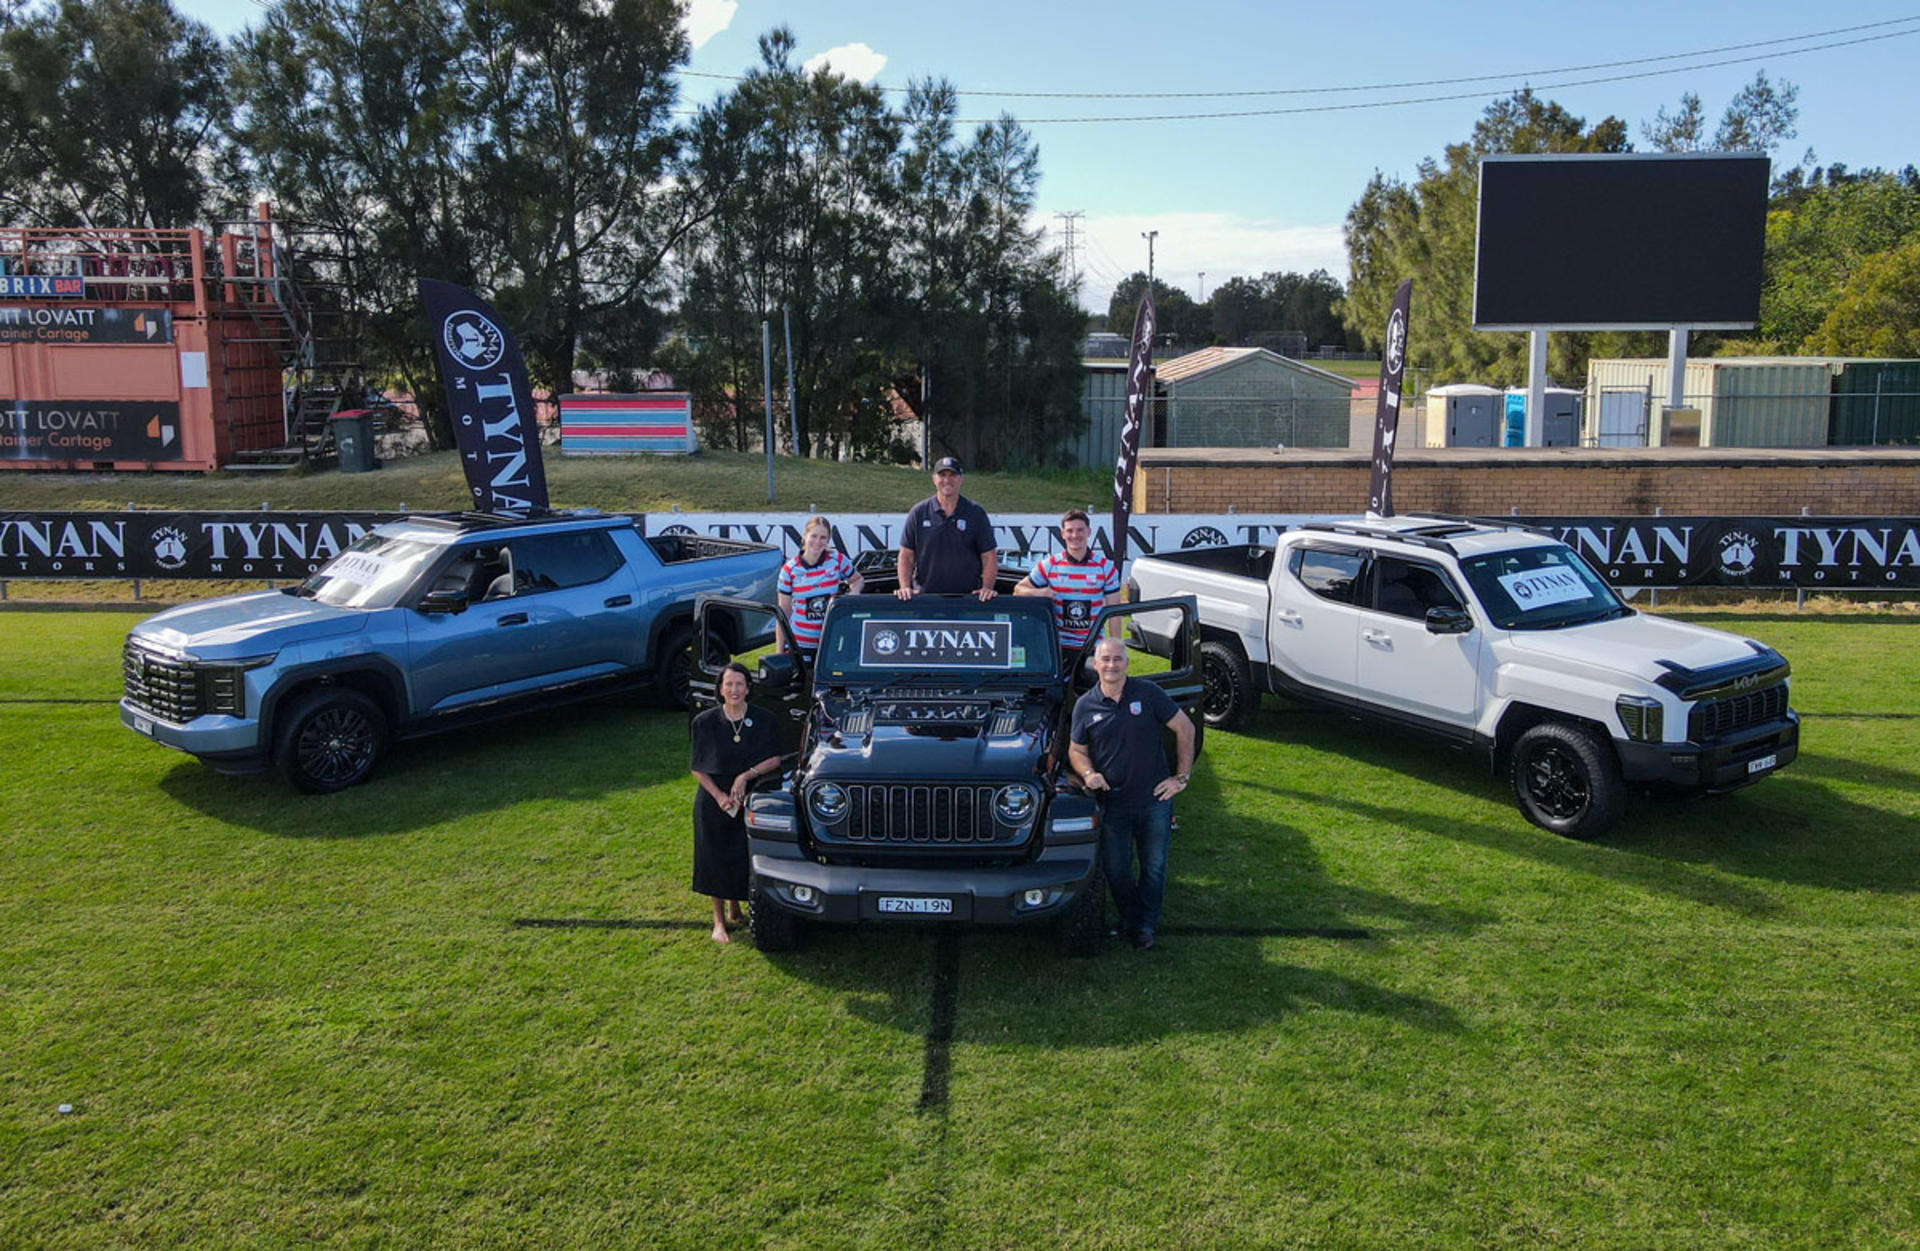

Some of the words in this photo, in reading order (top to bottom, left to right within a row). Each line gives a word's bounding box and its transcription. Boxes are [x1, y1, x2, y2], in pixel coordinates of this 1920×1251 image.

[54, 279, 81, 293] BAR
[28, 309, 95, 326] LOVATT
[0, 327, 33, 339] ainer
[37, 326, 89, 342] Cartage
[0, 411, 29, 430] TT
[38, 410, 119, 430] LOVATT
[48, 431, 112, 451] Cartage
[151, 526, 188, 541] TYNAN
[1719, 531, 1759, 548] TYNAN
[990, 525, 1160, 563] YNAN
[1779, 570, 1897, 580] MOTO
[905, 630, 997, 649] TYNAN
